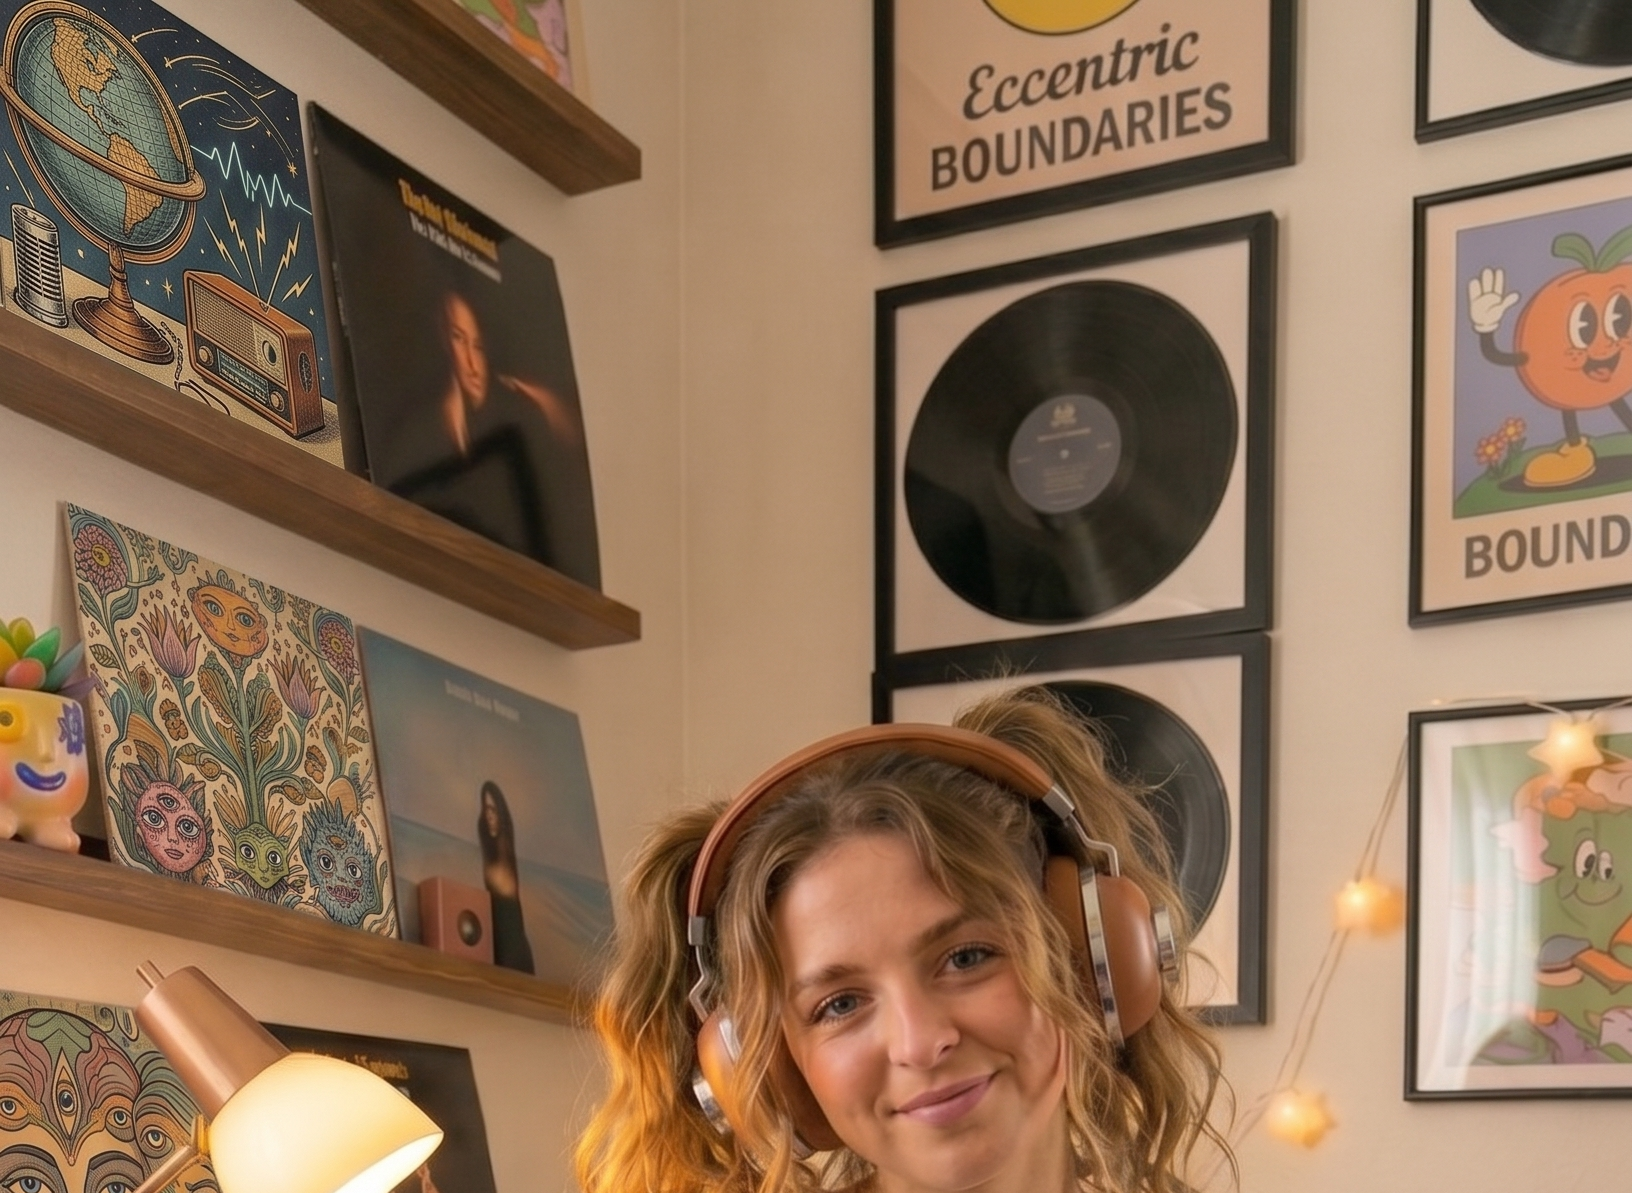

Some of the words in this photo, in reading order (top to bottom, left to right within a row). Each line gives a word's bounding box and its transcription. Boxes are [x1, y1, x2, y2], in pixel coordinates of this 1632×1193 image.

[962, 22, 1199, 121] Eccentric
[931, 82, 1233, 191] BOUNDARIES
[1464, 514, 1632, 579] BOUND
